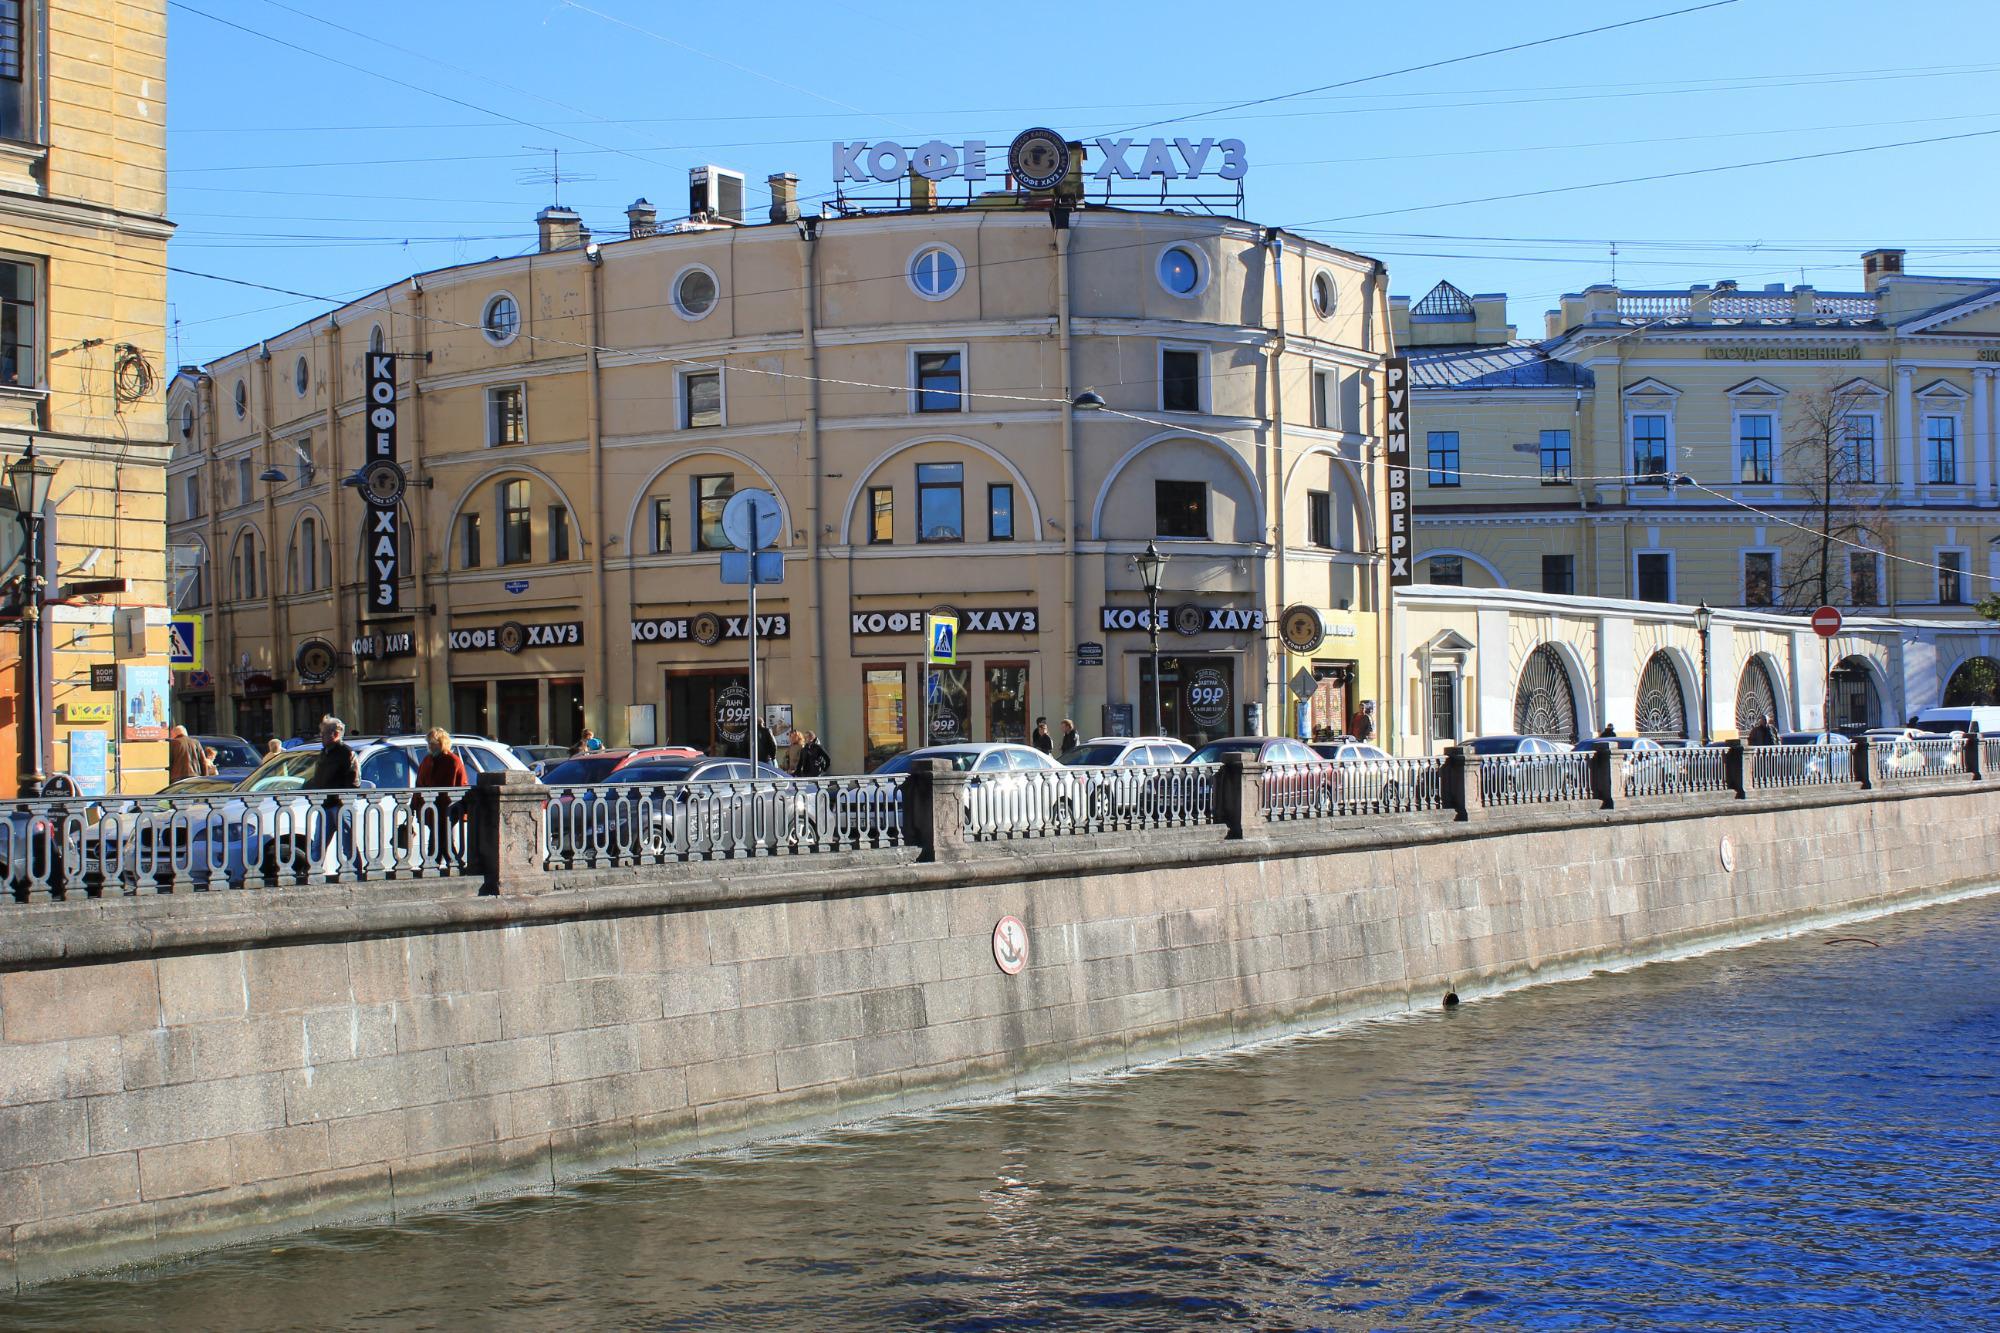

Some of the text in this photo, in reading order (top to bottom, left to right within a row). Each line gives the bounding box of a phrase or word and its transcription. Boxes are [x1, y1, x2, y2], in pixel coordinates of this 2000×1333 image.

[833, 140, 986, 182] КОФЕ
[1094, 138, 1248, 180] ХАУЗ
[1019, 173, 1038, 186] КОФЕ
[1705, 345, 1862, 361] ГОСУДАРСТВЕННЫЙ
[371, 356, 395, 454] КОФЕ
[1388, 368, 1408, 577] РУКИ ВВЕРХ
[374, 511, 395, 605] ХАУЗ
[631, 620, 687, 640] КОФЕ
[852, 611, 1035, 633] КОФЕ ХАУЗ
[1103, 609, 1265, 630] КОФЕ ХАУЗ
[352, 633, 409, 655] КОФЕ ХАУЗ
[449, 625, 578, 649] КОФЕ ХАУЗ
